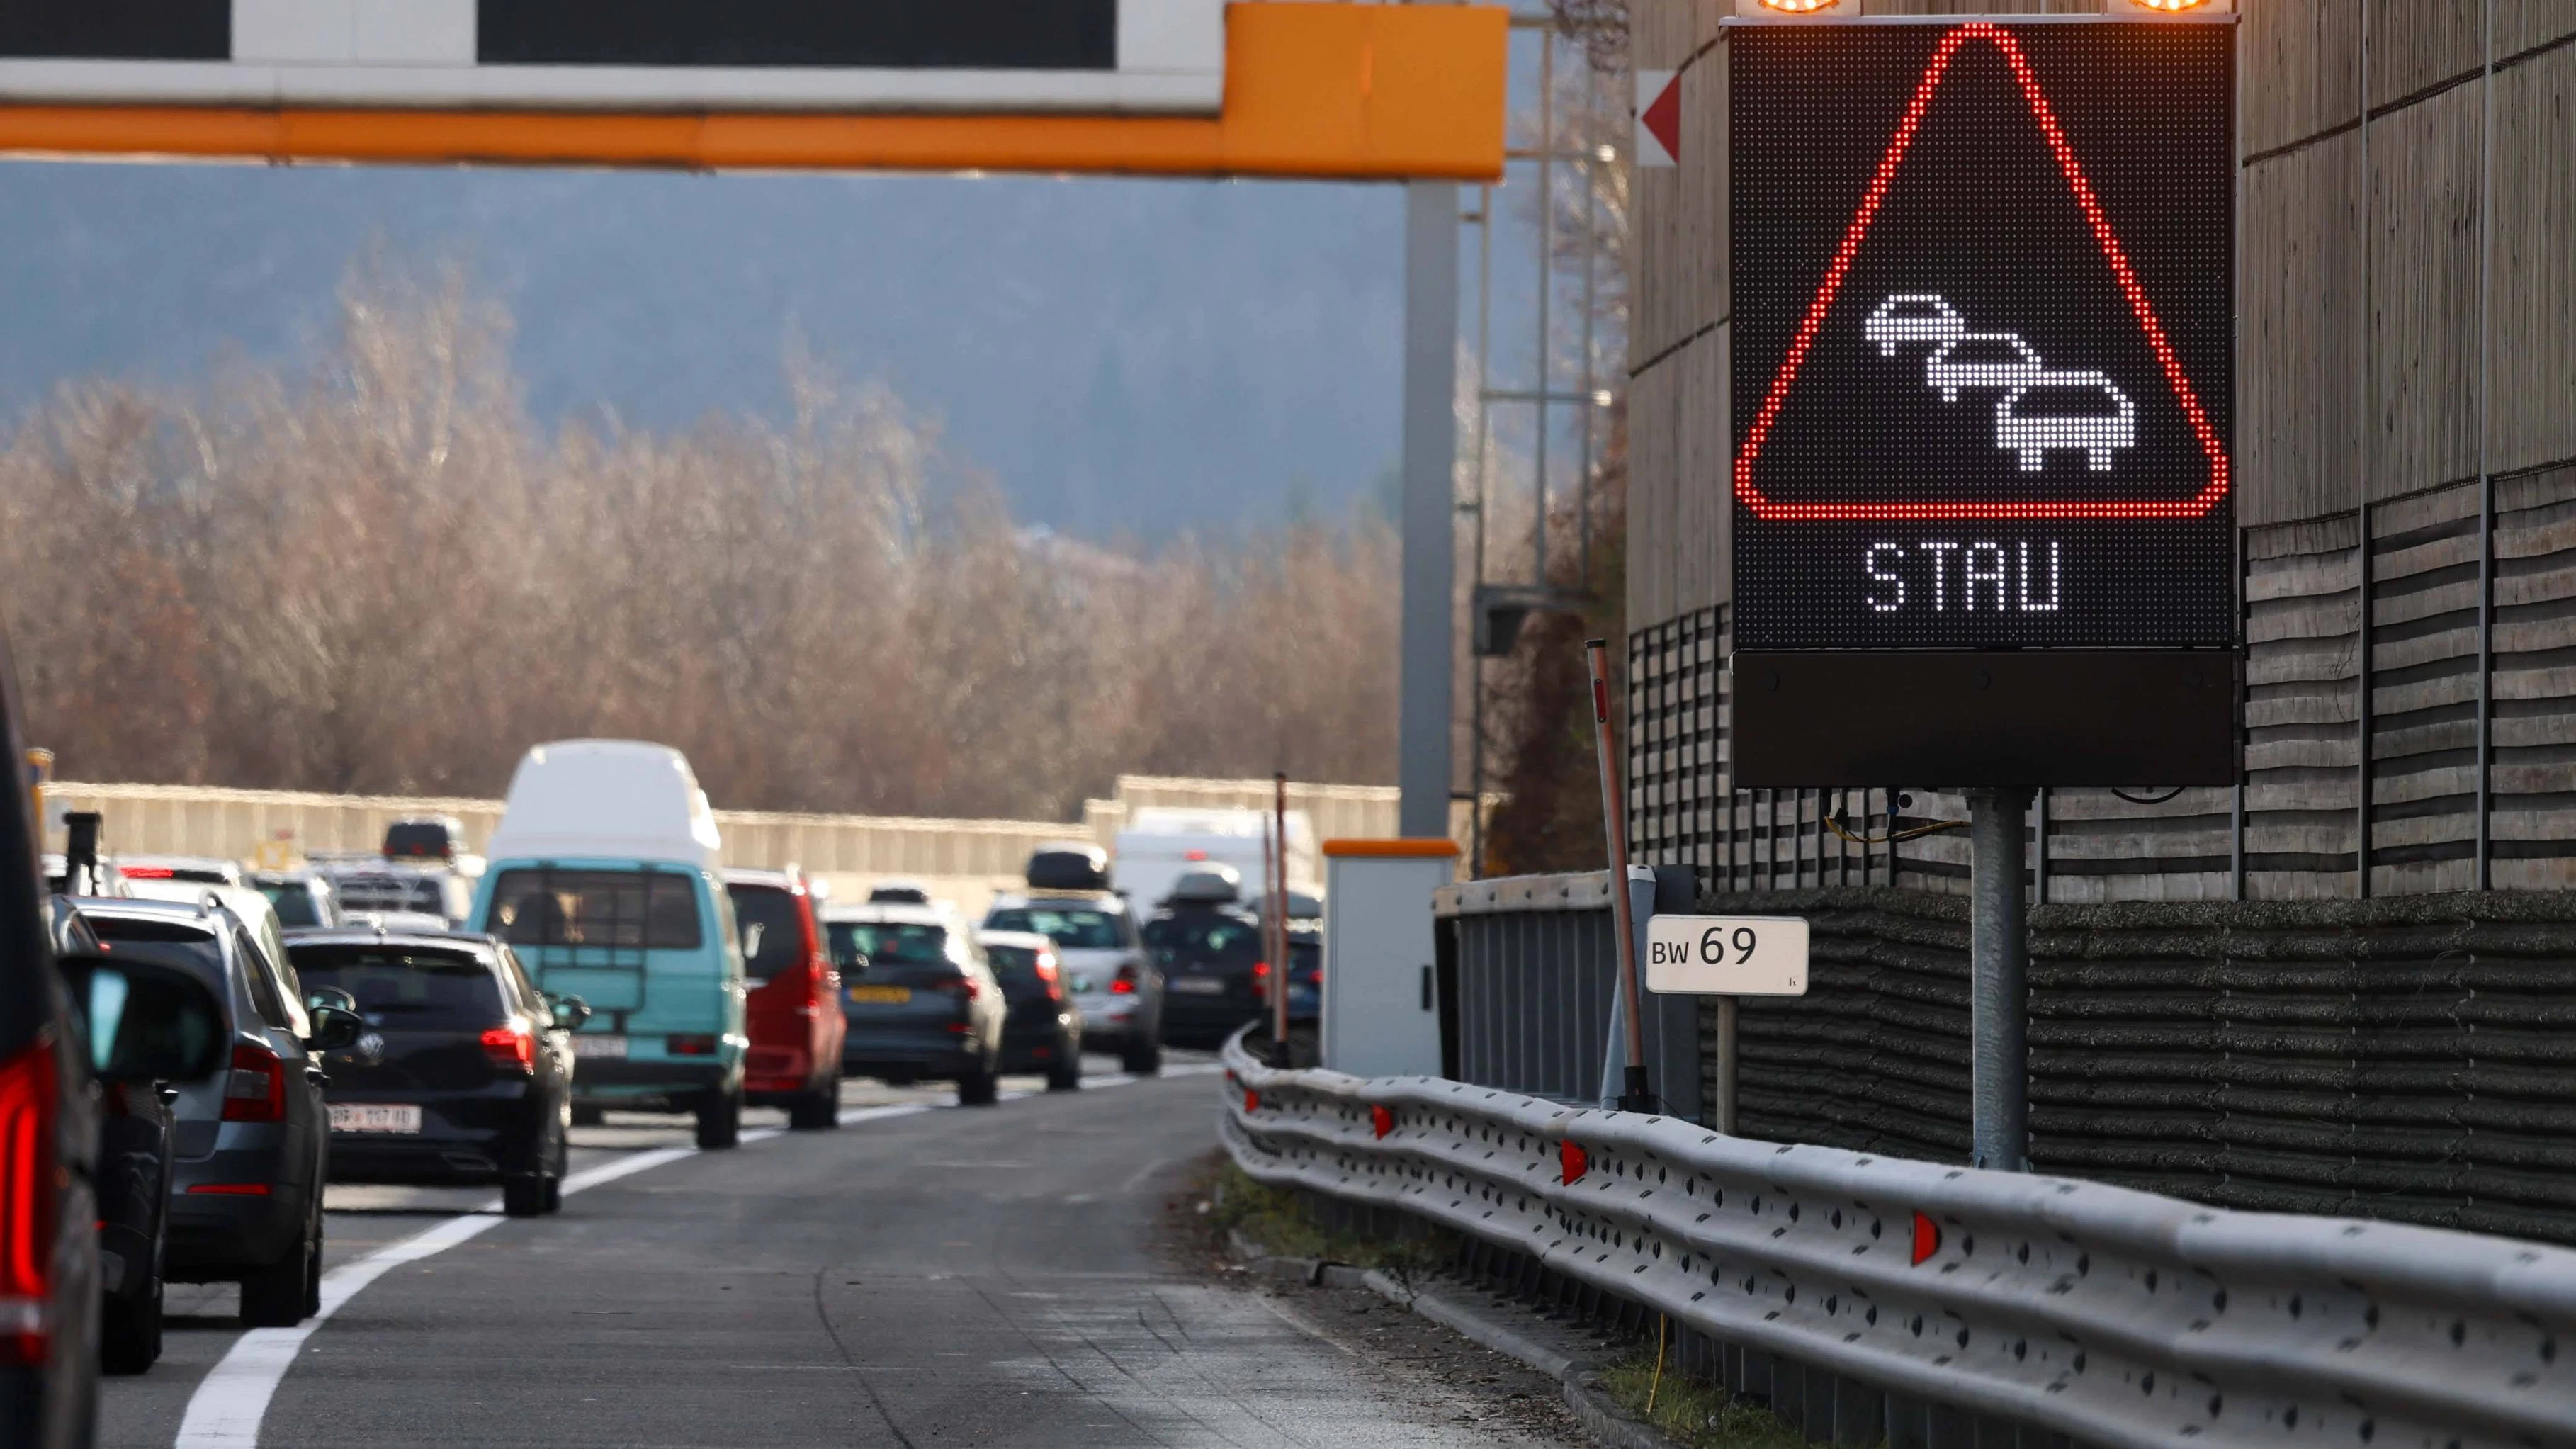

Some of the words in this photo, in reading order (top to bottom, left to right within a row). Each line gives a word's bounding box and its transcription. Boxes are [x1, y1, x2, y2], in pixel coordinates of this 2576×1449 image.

[1865, 541, 2059, 612] STAU
[1651, 941, 1690, 964] BW
[1700, 926, 1756, 965] 69
